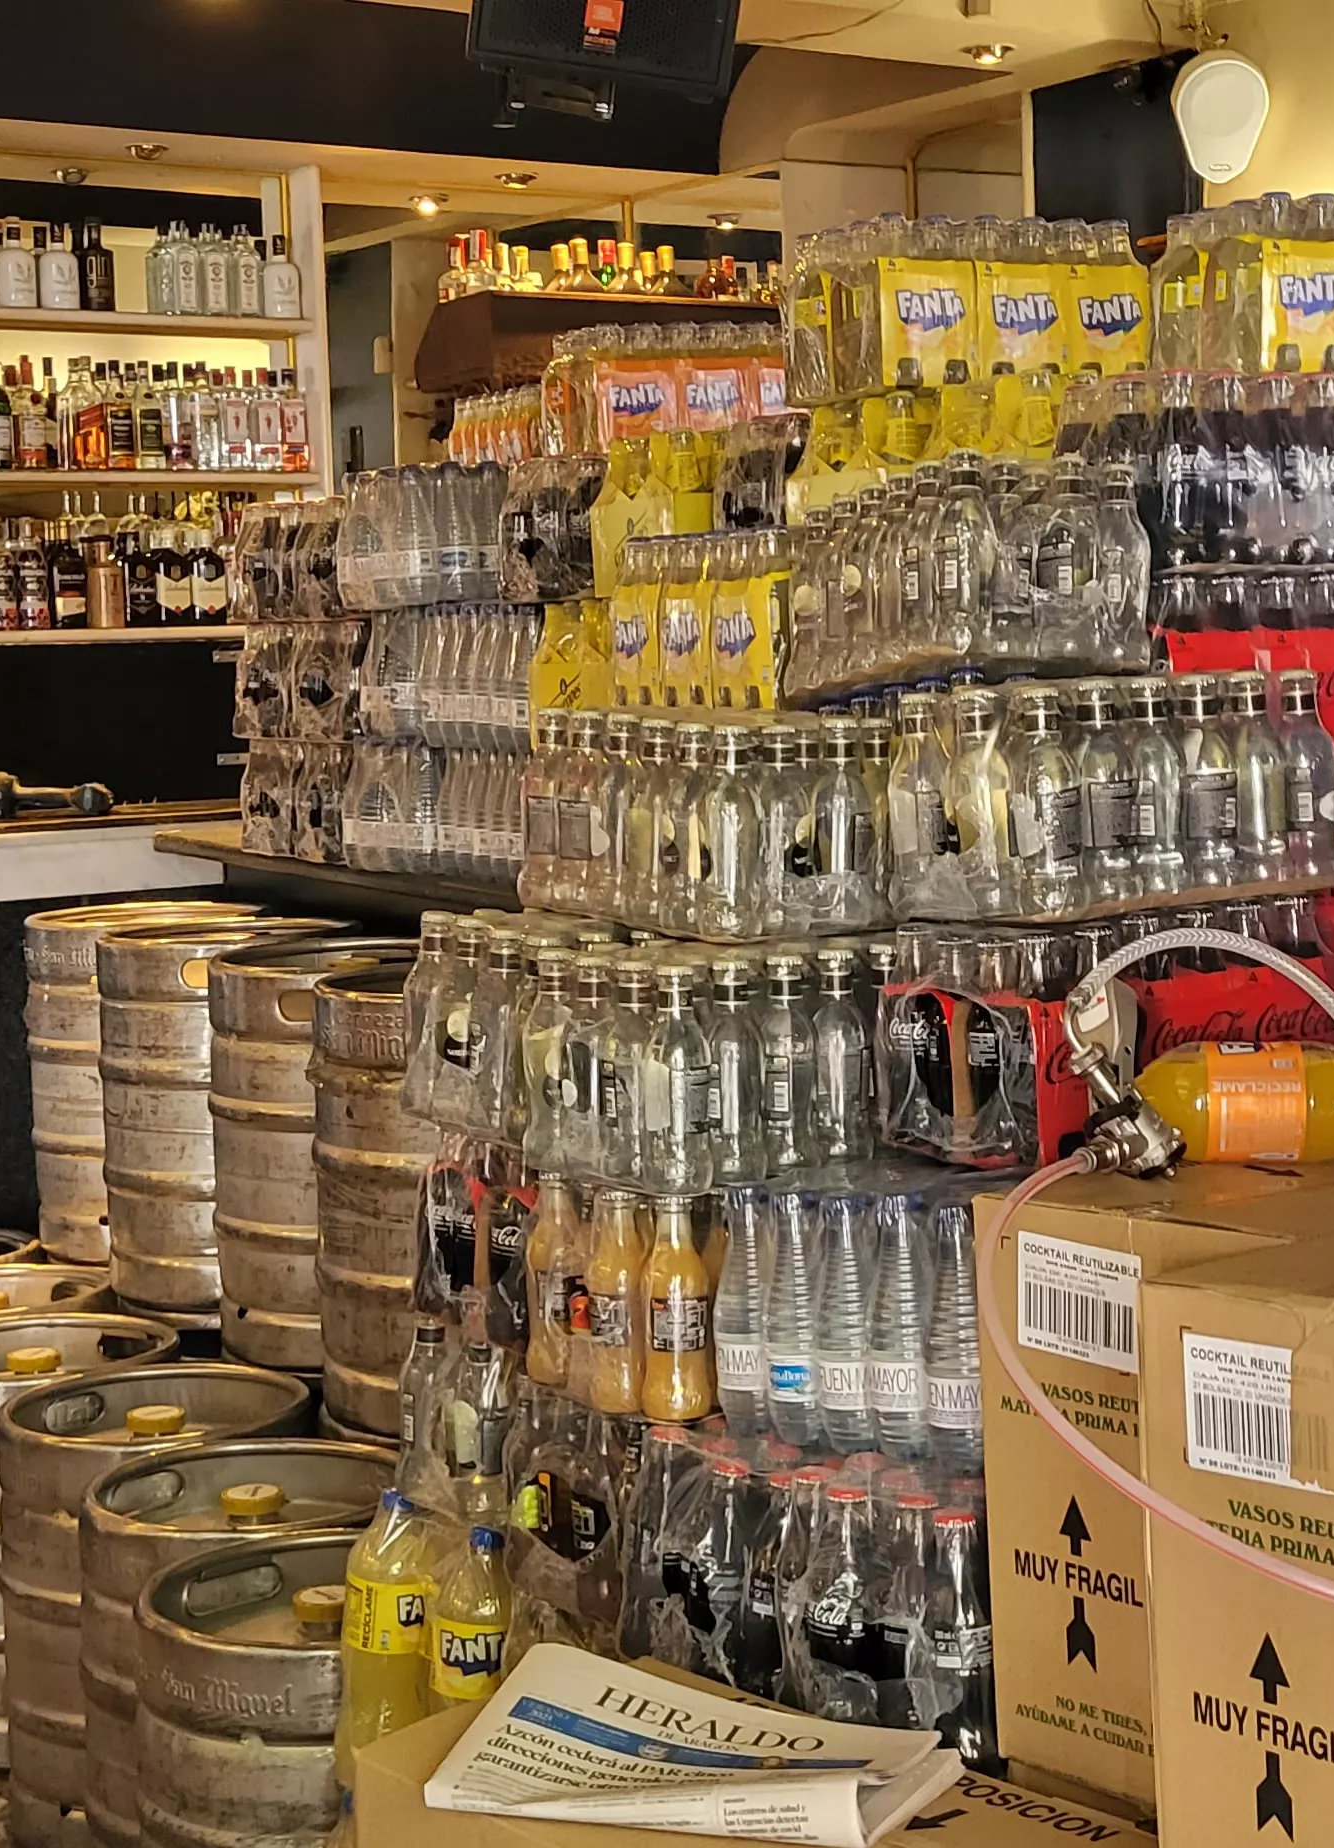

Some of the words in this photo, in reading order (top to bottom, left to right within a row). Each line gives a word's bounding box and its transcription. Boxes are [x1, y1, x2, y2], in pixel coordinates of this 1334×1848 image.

[896, 288, 966, 322] FANTA
[992, 293, 1058, 324] FANTA
[1079, 293, 1142, 325] FANTA
[609, 382, 665, 409] FANTA
[686, 380, 739, 410] FANTA
[1023, 1242, 1070, 1263] COCKTAIL
[1072, 1253, 1140, 1279] REUTILIZABLE
[1190, 1346, 1248, 1368] COCKTAIL
[1041, 1382, 1095, 1406] VASOS
[1074, 1410, 1128, 1436] PRIMA
[1227, 1498, 1296, 1530] VASOS
[1014, 1549, 1058, 1585] MUY
[1065, 1560, 1144, 1608] FRAGIL
[200, 1675, 296, 1719] Miguel
[1055, 1694, 1076, 1713] NO
[1078, 1702, 1099, 1720] ME
[1192, 1691, 1249, 1735] MUY
[594, 1685, 825, 1753] HERALDO
[1015, 1702, 1078, 1734] AYÚDAME
[1080, 1723, 1091, 1737] A
[1093, 1727, 1145, 1755] CUIDAR
[487, 1736, 588, 1776] direcciones
[496, 1723, 556, 1748] Azcón
[558, 1743, 619, 1769] cederá
[619, 1760, 638, 1773] al
[638, 1764, 682, 1777] PAR
[473, 1751, 588, 1788] garantizarse
